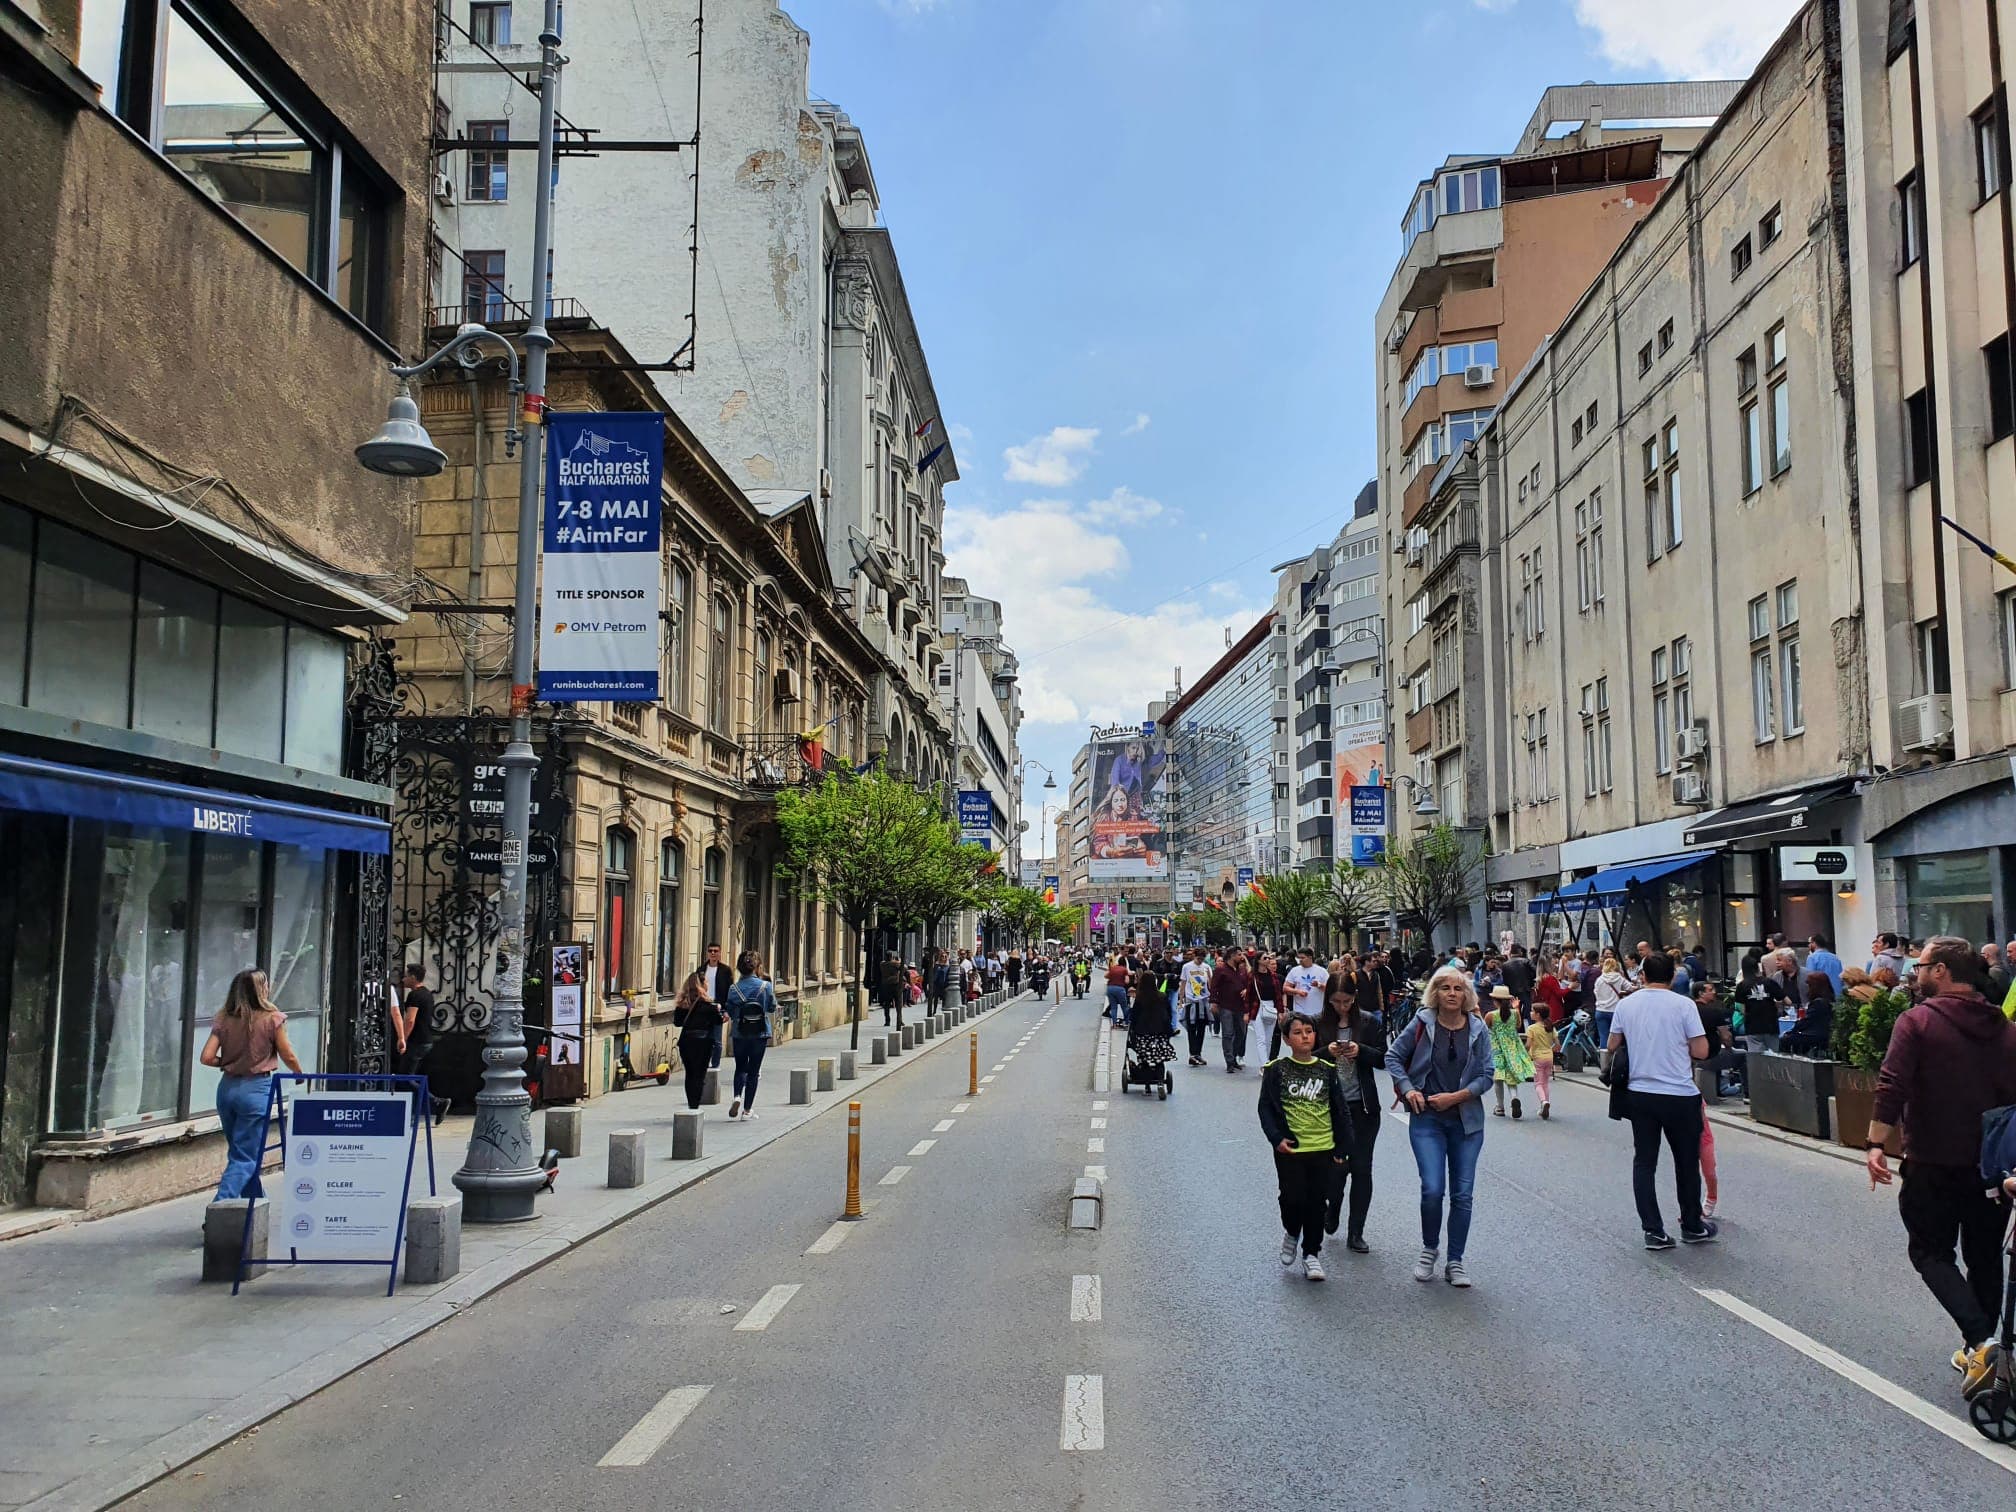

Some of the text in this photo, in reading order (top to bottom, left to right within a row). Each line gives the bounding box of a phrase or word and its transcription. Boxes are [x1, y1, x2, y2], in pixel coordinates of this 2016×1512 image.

[560, 458, 649, 475] Bucharest
[560, 475, 649, 485] HALF MARATHON
[558, 500, 648, 519] 7-8 MAI
[556, 525, 648, 543] #AimFar
[556, 590, 645, 599] TITLE SPONSOR
[571, 622, 646, 631] OMV Petrom
[553, 680, 644, 688] runinbucharest.com
[1090, 721, 1143, 742] Radisson
[194, 807, 253, 836] LIBERTÉ
[323, 1106, 376, 1121] LIBERTÉ
